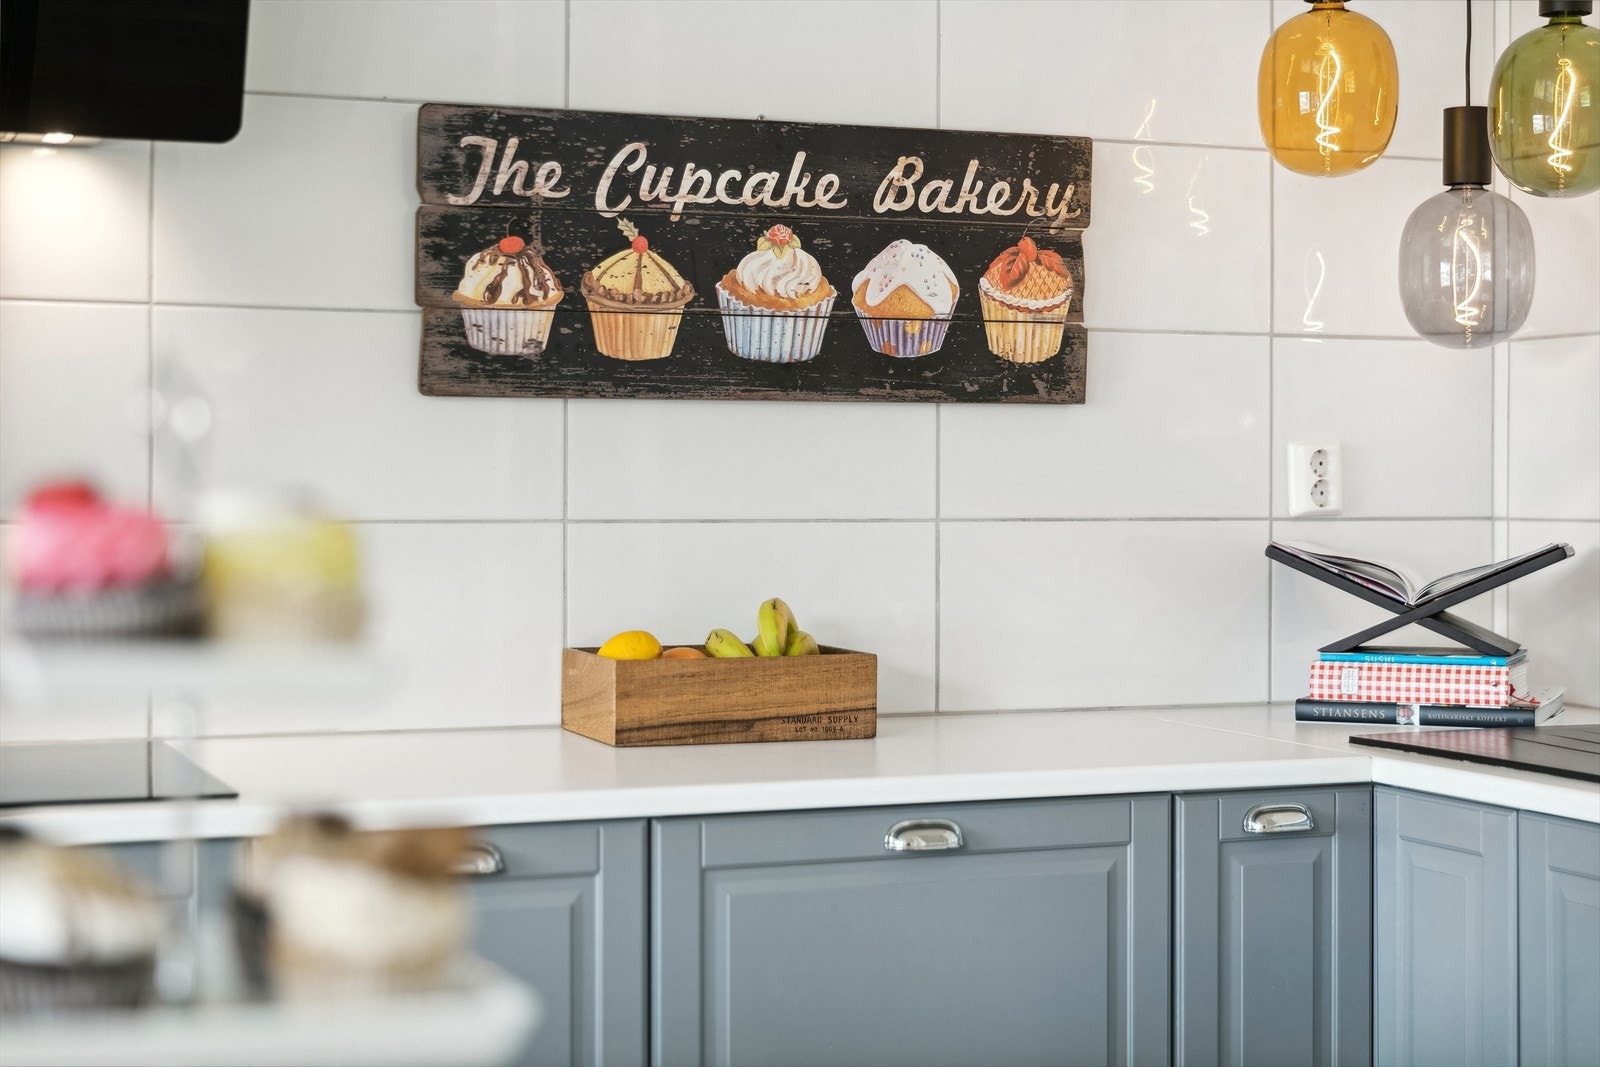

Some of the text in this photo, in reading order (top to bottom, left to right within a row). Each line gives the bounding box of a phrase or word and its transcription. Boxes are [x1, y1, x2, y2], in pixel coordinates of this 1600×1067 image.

[446, 135, 1082, 234] The Cupcake Bakery
[1364, 655, 1396, 664] SUSHI
[1312, 706, 1386, 720] STIANSENS
[781, 715, 858, 724] STANDARD SUPPLY
